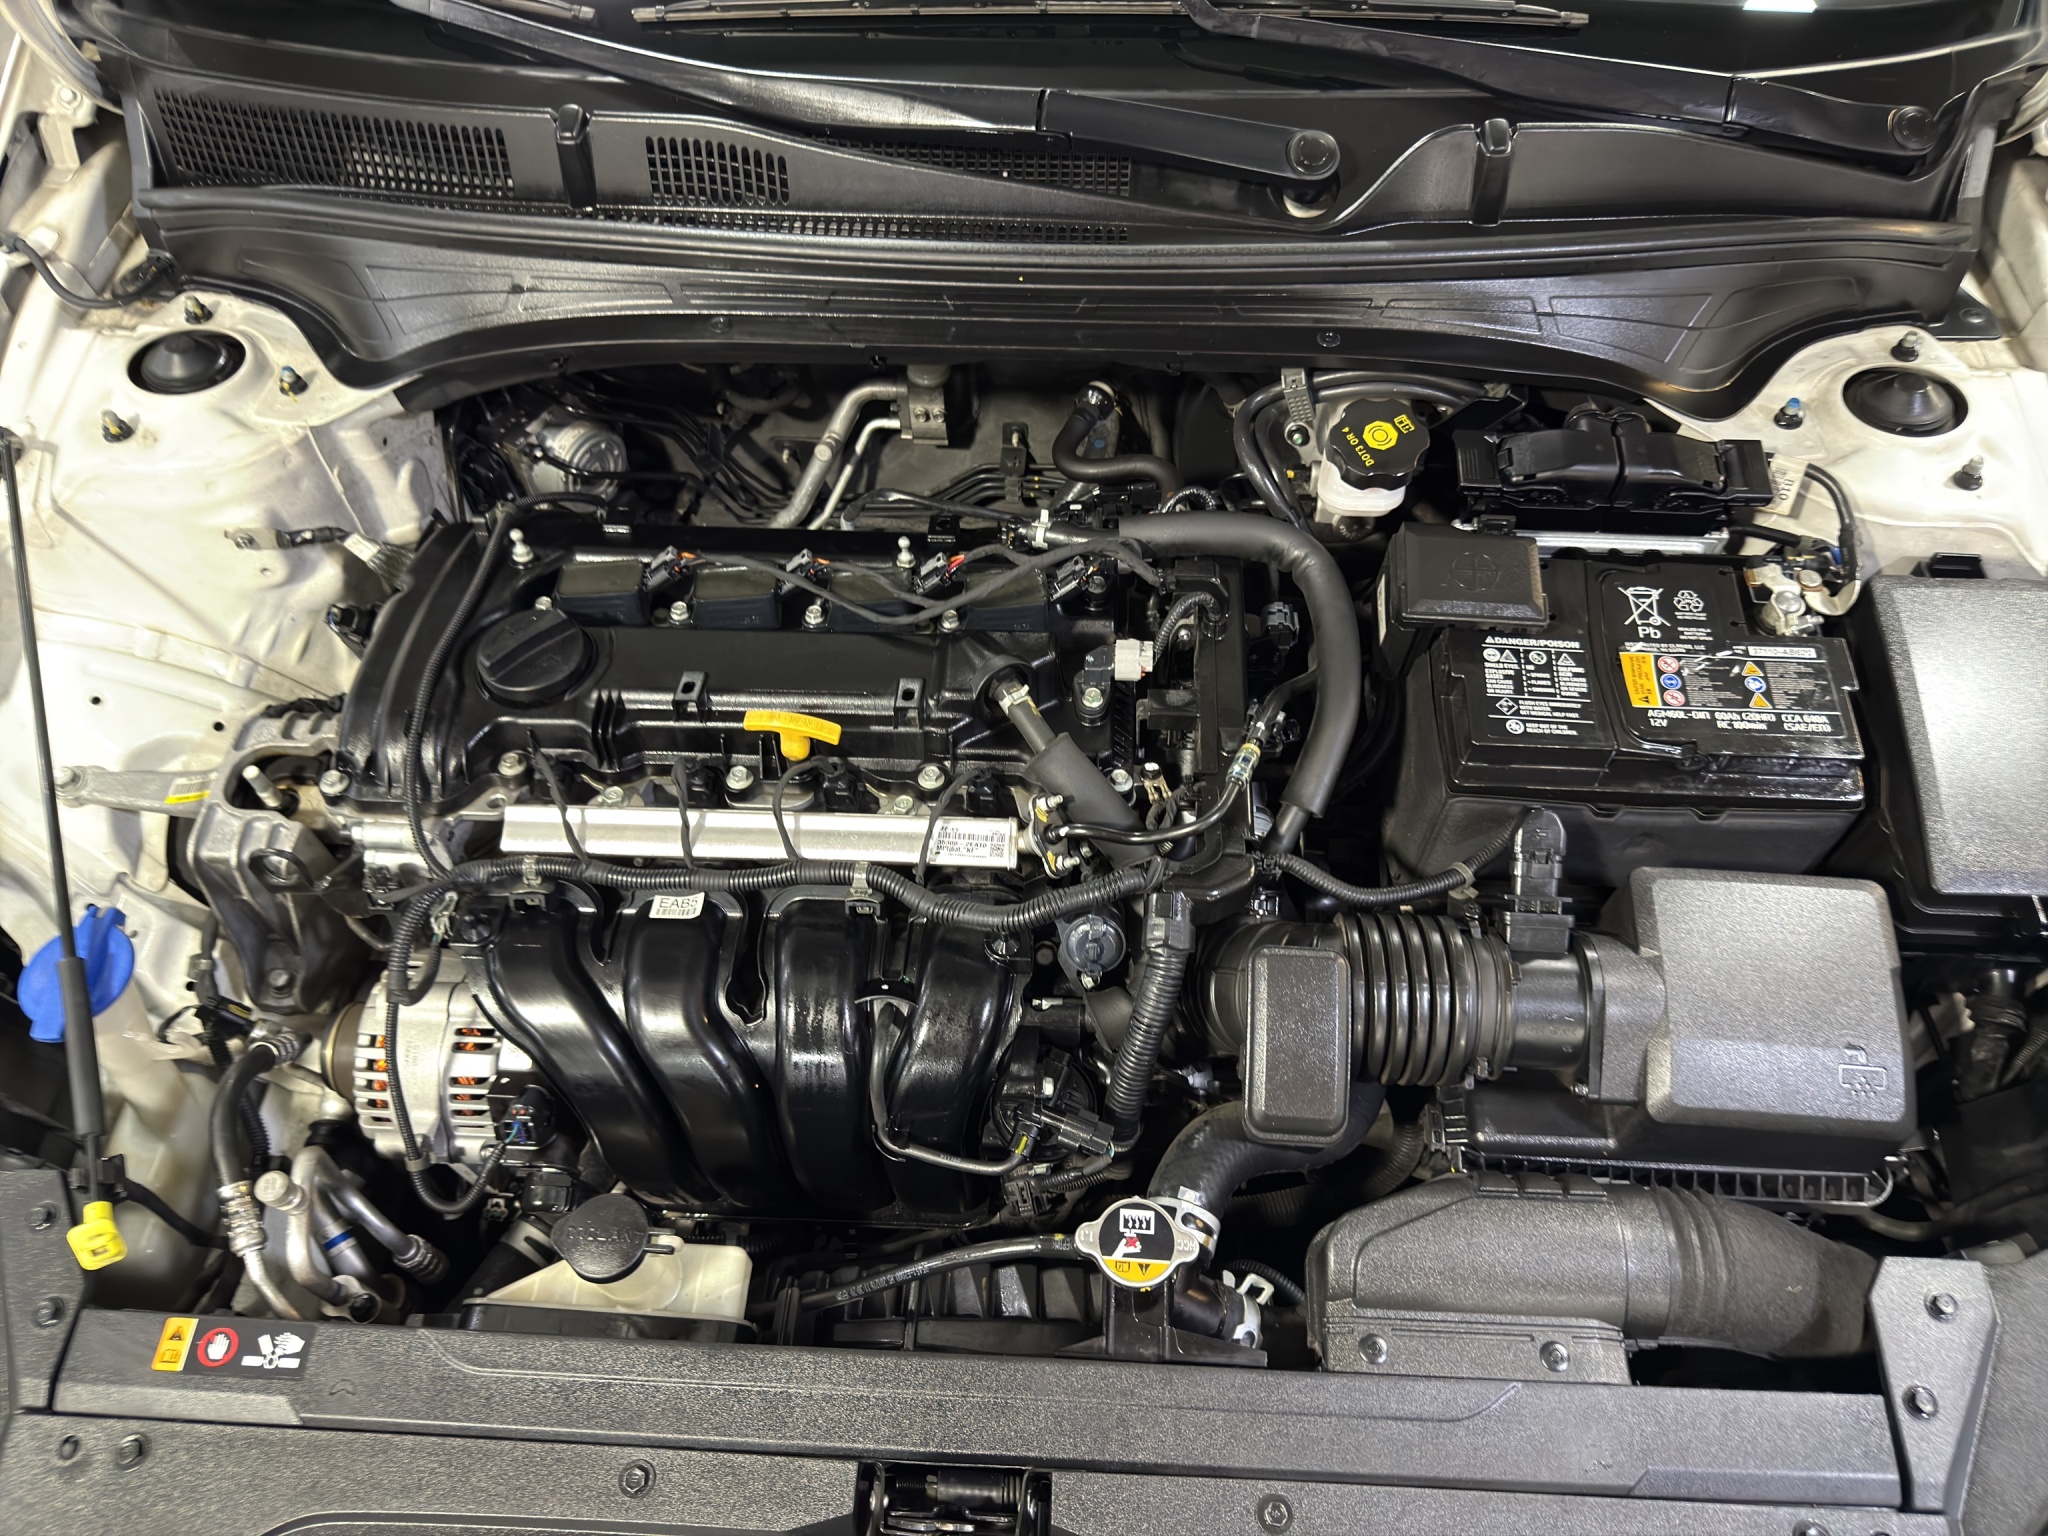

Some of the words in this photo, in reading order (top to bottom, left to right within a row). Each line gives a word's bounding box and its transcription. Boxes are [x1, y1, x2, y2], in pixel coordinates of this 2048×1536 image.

[1346, 432, 1359, 446] OR
[1355, 445, 1375, 467] DOT3
[1638, 626, 1662, 640] Pb
[1494, 637, 1580, 649] DANGER/POISON
[1649, 718, 1668, 727] 12V
[1717, 720, 1732, 729] RC
[1732, 721, 1767, 730] 100min
[1781, 714, 1802, 723] CCA
[659, 896, 699, 909] EAB5
[1177, 1239, 1196, 1252] HCC
